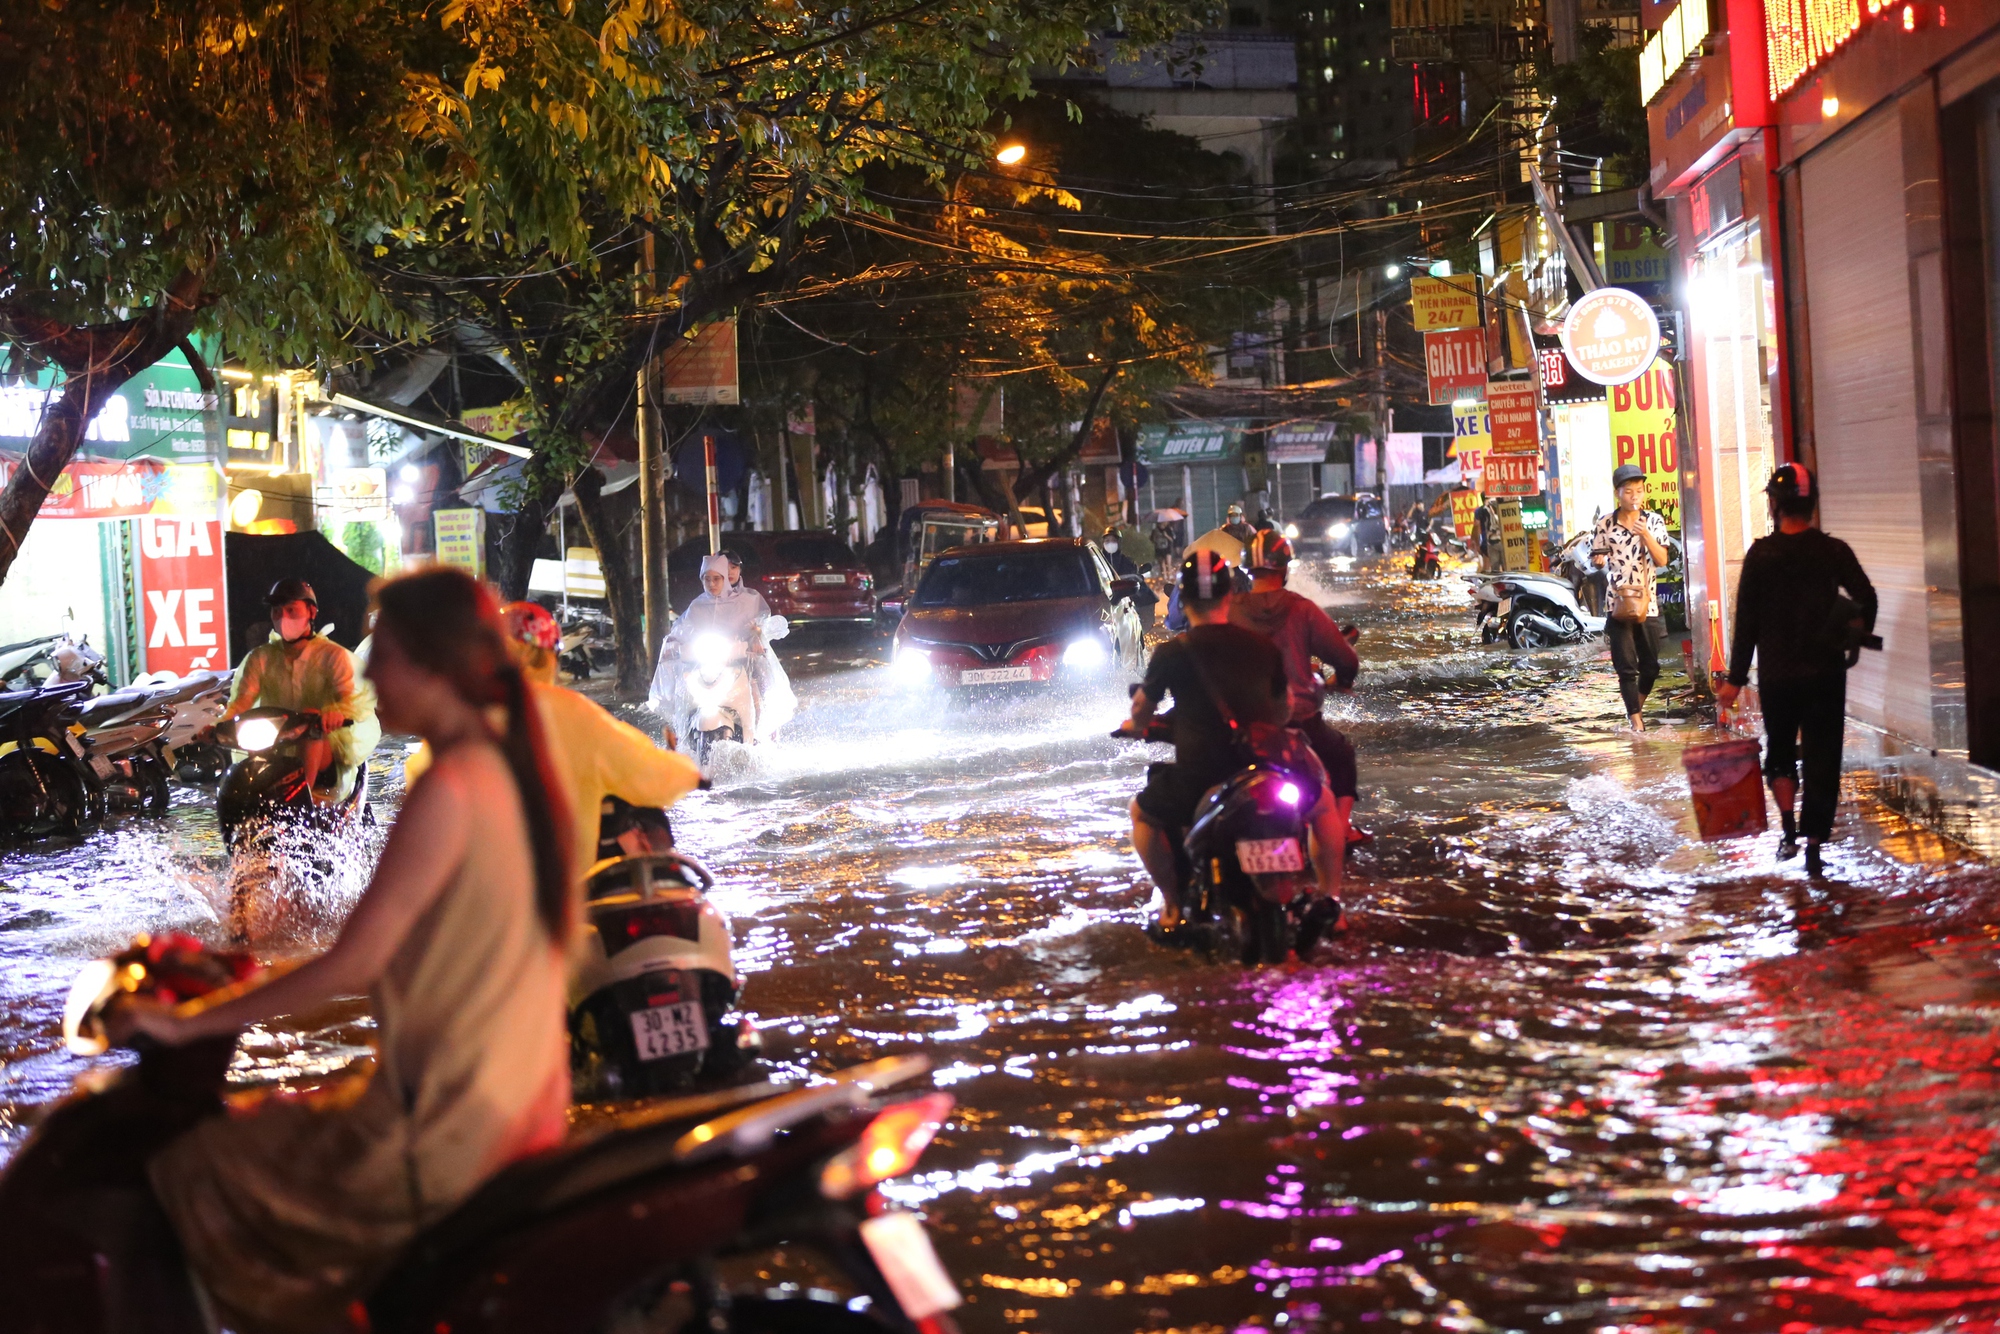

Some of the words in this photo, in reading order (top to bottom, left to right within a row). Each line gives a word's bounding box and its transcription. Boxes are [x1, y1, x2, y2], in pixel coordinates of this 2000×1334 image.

[1441, 296, 1471, 307] NHANH
[1428, 309, 1464, 325] 24/7
[1428, 336, 1462, 384] GIẶT
[1465, 333, 1486, 375] LÀ
[1591, 354, 1642, 372] BAKERY
[1435, 383, 1454, 402] LẤY
[1457, 385, 1484, 400] NGAY
[1493, 383, 1528, 392] viettel
[1455, 415, 1478, 436] XE
[1509, 411, 1532, 423] NHANH
[1507, 427, 1521, 438] 24/7
[1459, 450, 1482, 471] XE
[1486, 459, 1516, 485] GIẶT
[1518, 458, 1535, 480] LÀ
[1508, 484, 1532, 492] NGAY
[146, 588, 217, 648] XE
